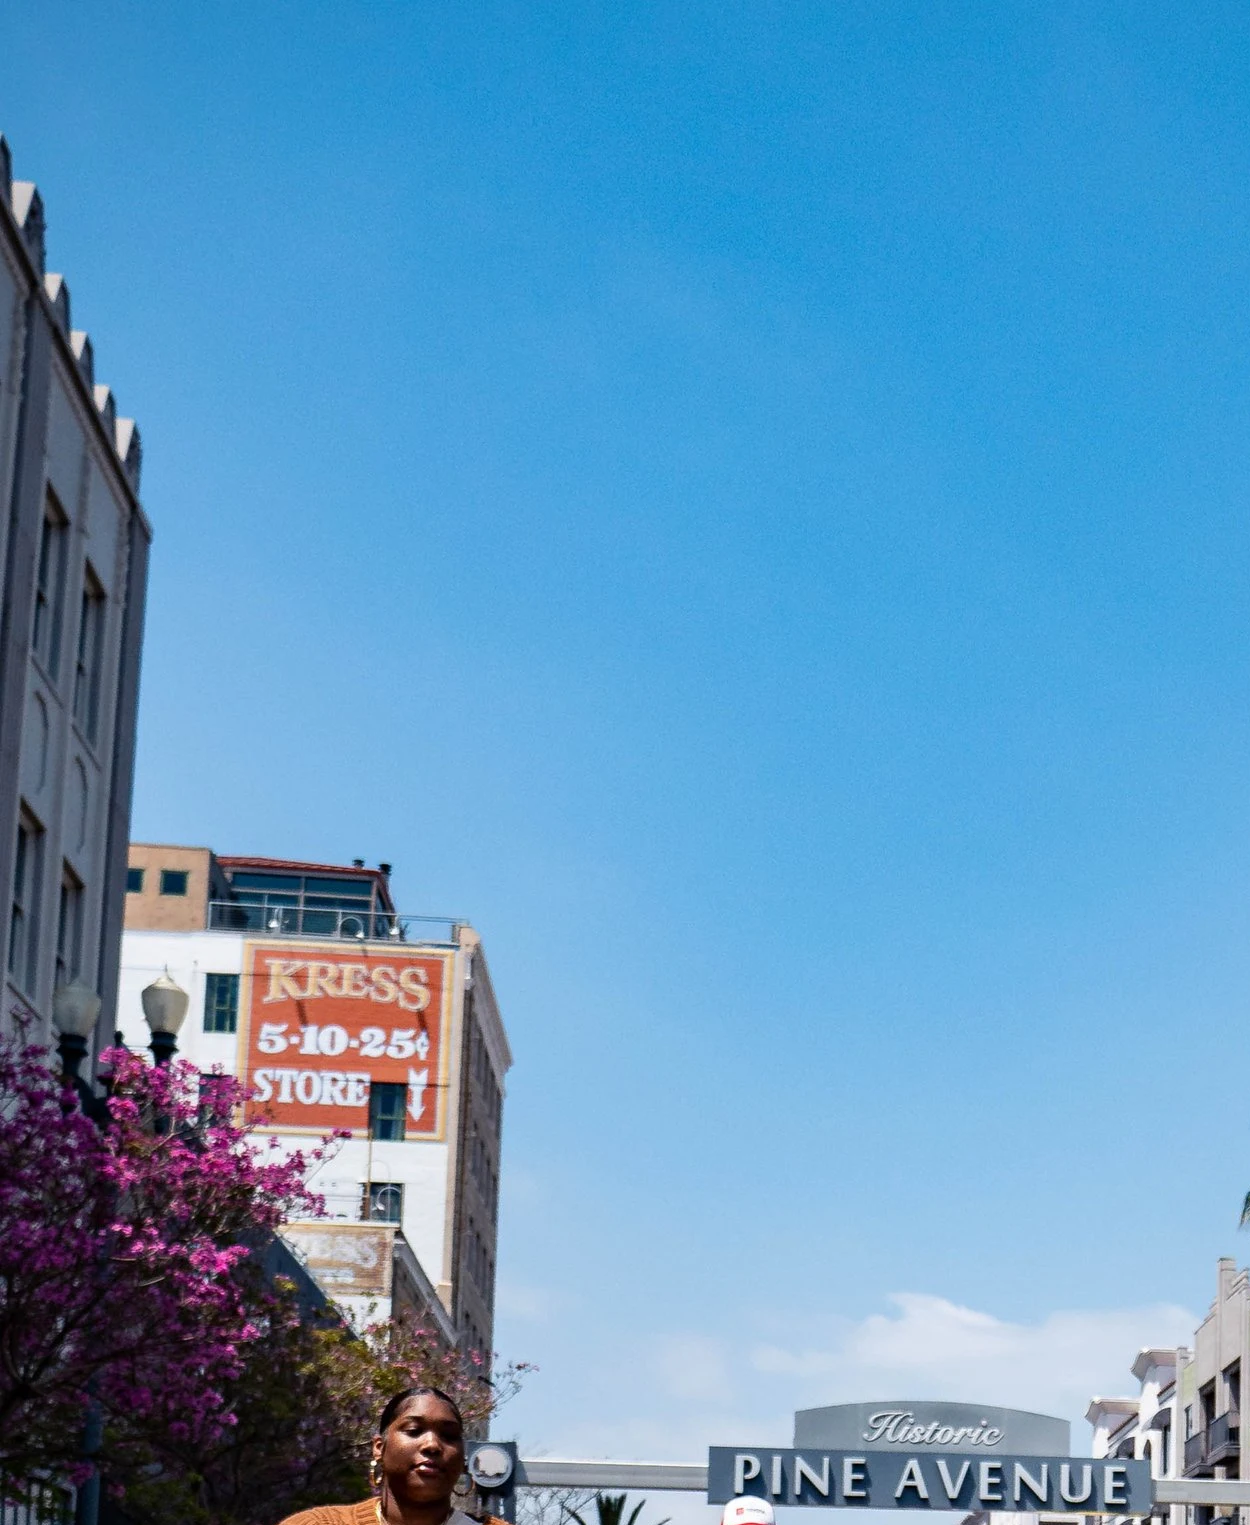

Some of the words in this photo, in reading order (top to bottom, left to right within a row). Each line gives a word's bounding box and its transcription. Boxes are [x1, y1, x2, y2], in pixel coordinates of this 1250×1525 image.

[263, 959, 431, 1012] KRESS
[252, 1067, 372, 1107] STORE
[863, 1410, 1005, 1446] Historic
[734, 1454, 867, 1497] PINE
[895, 1458, 1127, 1504] AVENUE
